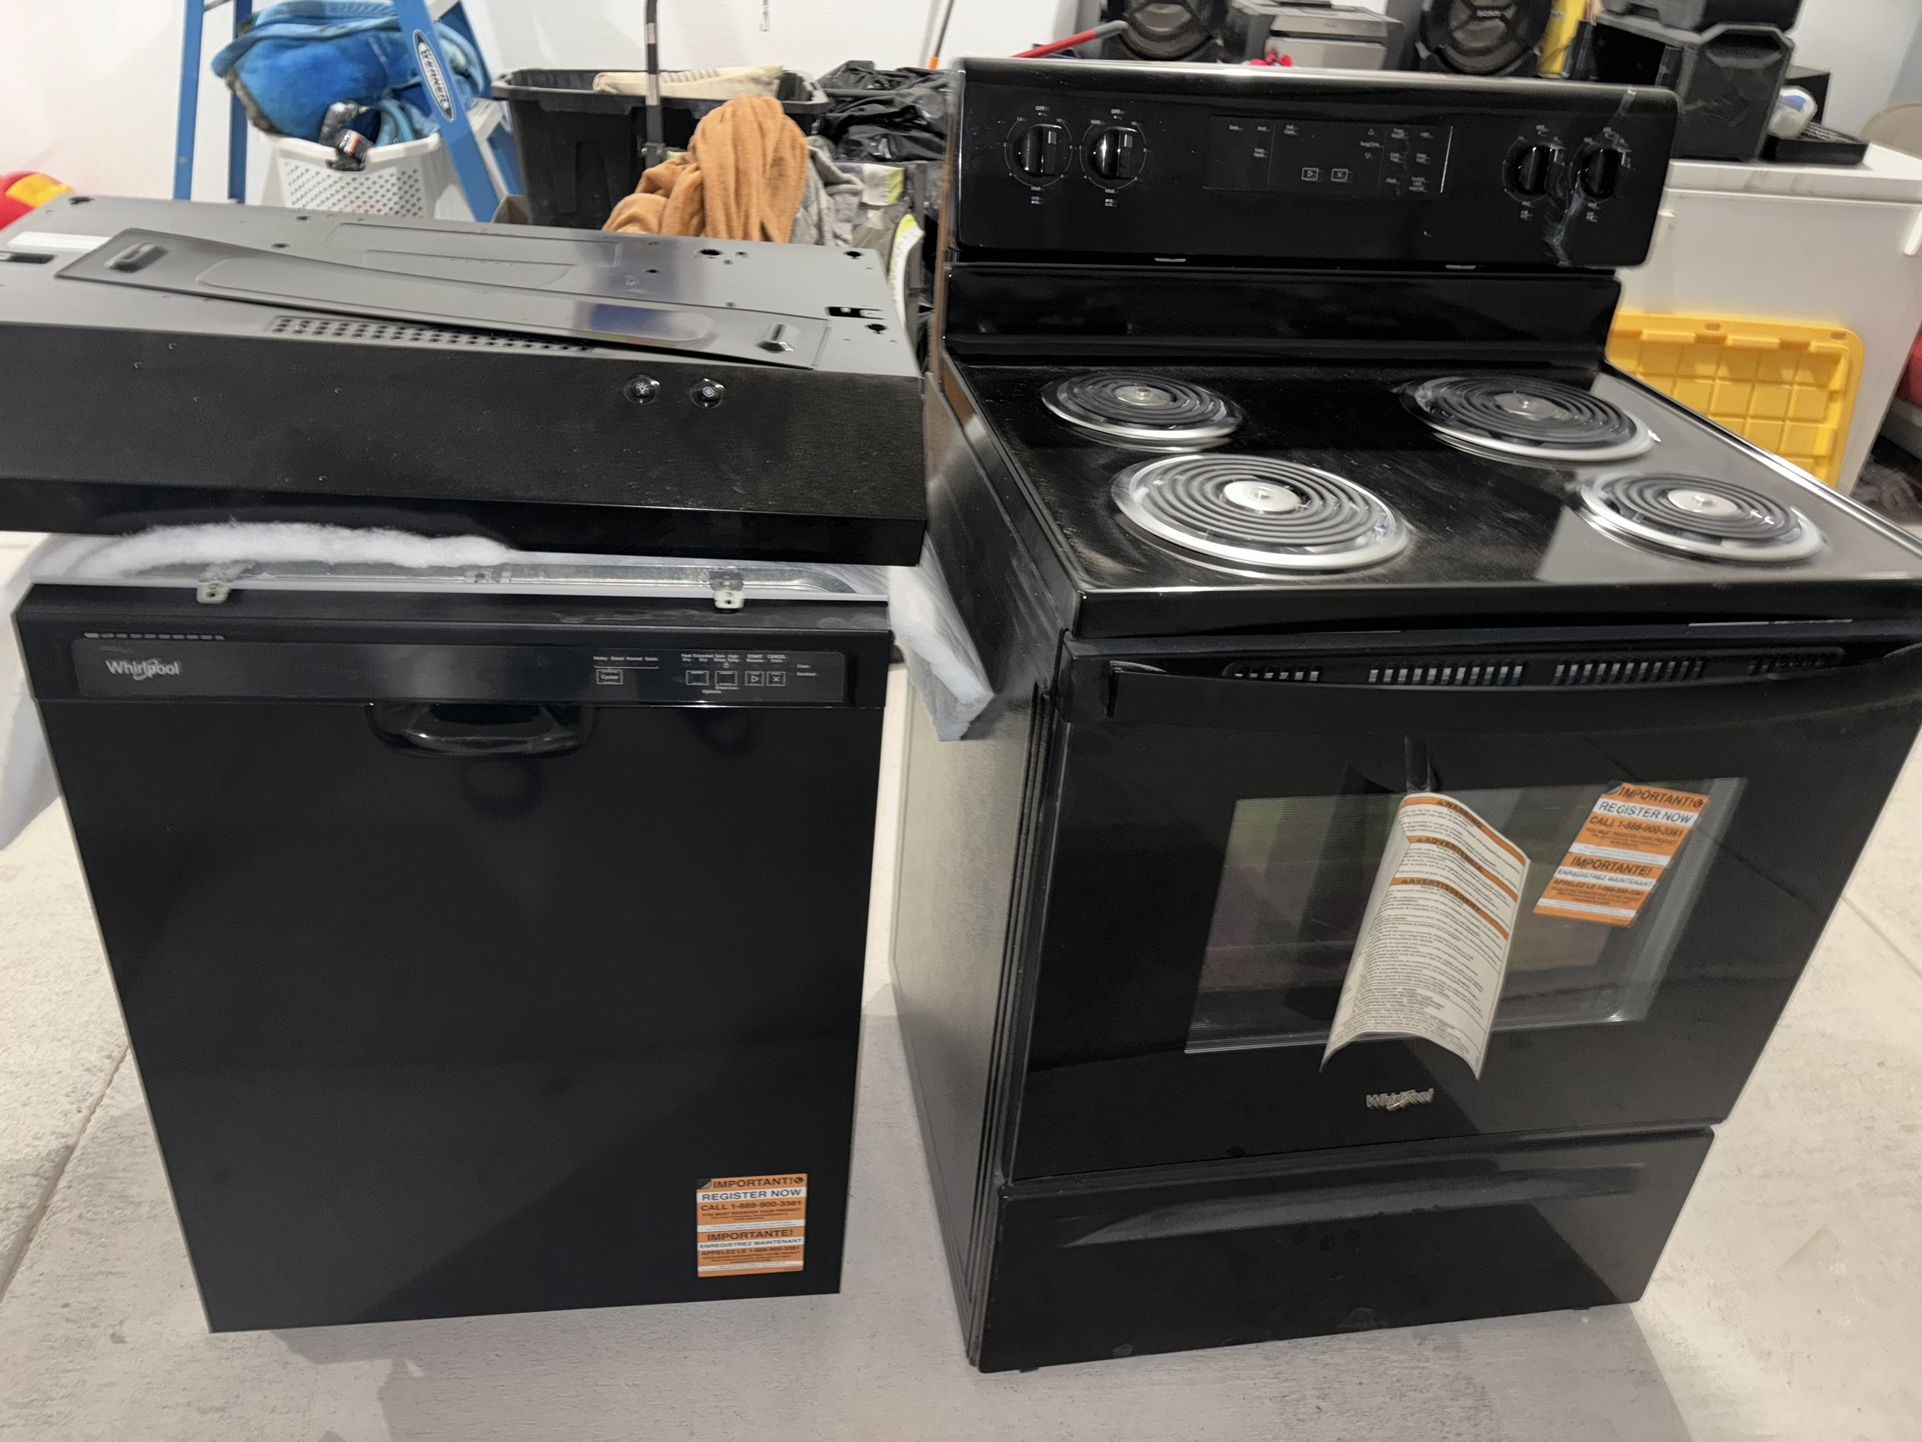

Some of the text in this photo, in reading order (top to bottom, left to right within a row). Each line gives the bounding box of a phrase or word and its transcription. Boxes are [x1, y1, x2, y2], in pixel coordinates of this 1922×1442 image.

[105, 658, 180, 680] Whirlpool
[1599, 801, 1693, 824] REGISTER NOW
[1589, 815, 1616, 829] CALL
[1570, 856, 1653, 876] IMPORTANTE!
[713, 1177, 793, 1189] IMPORTANT!
[702, 1188, 802, 1202] REGISTER NOW
[700, 1203, 728, 1211] CALL
[707, 1229, 793, 1242] IMPORTANTE!
